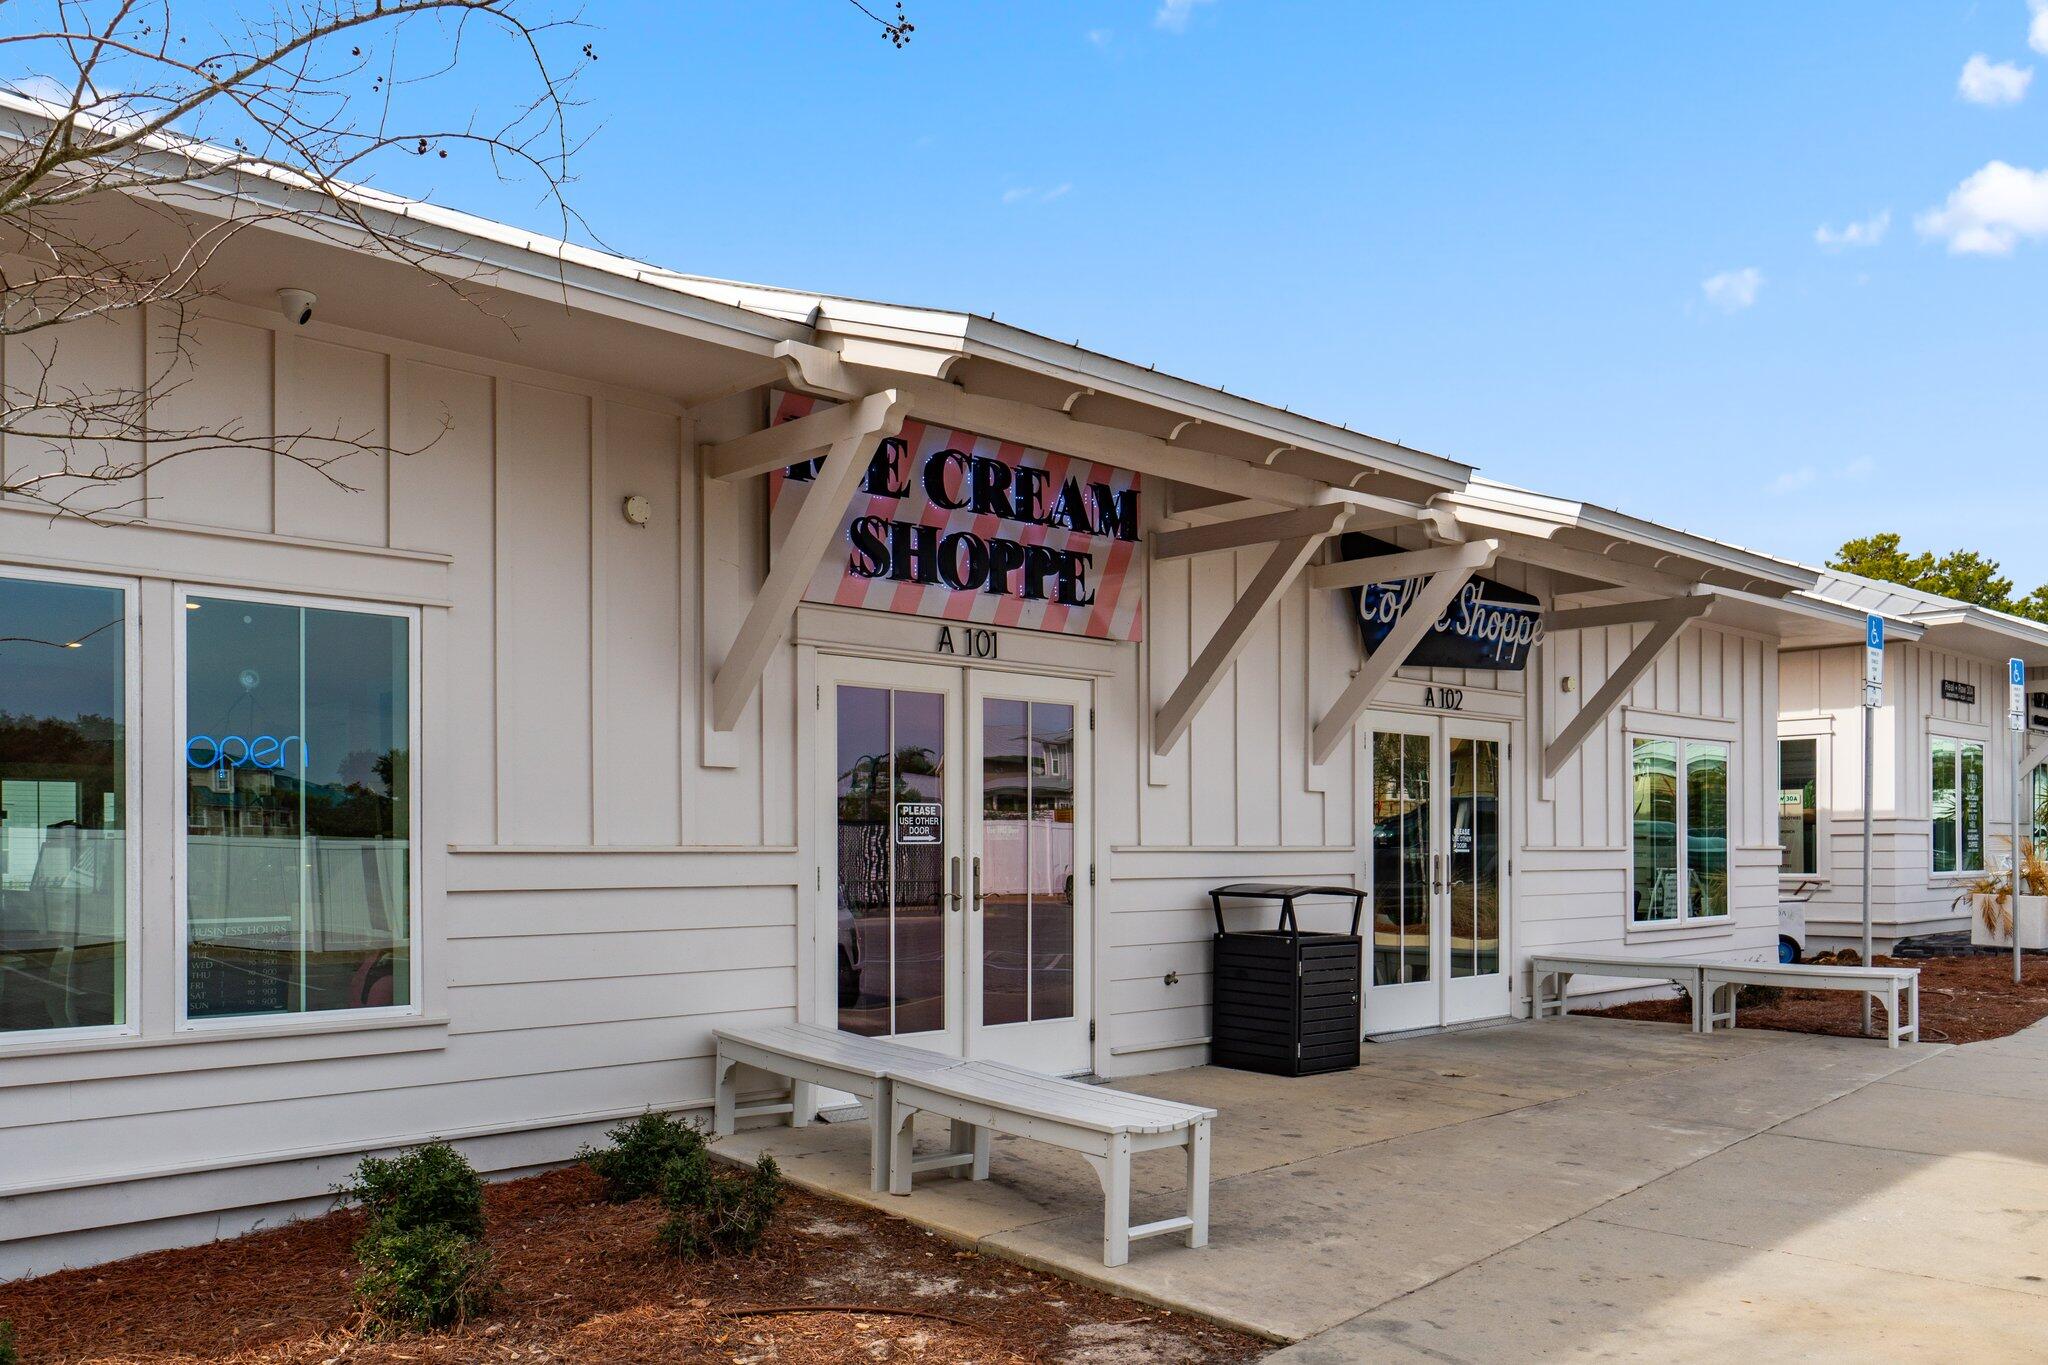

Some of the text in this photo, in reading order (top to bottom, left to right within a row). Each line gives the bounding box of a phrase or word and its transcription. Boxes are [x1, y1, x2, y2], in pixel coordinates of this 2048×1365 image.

[923, 448, 1142, 542] CREAM
[848, 515, 1095, 607] SHOPPE
[1360, 576, 1545, 664] Cofe Shoppe
[938, 626, 998, 659] A 101
[1425, 687, 1463, 711] A 102
[187, 735, 309, 778] open
[903, 806, 936, 815] PLEASE
[900, 817, 939, 825] USE OTHER
[909, 826, 930, 834] DOOR
[192, 925, 287, 937] BUSINESS HOURS
[192, 961, 213, 969] WED
[192, 971, 211, 979] THU
[190, 981, 204, 989] FRI
[190, 991, 206, 999] SAT
